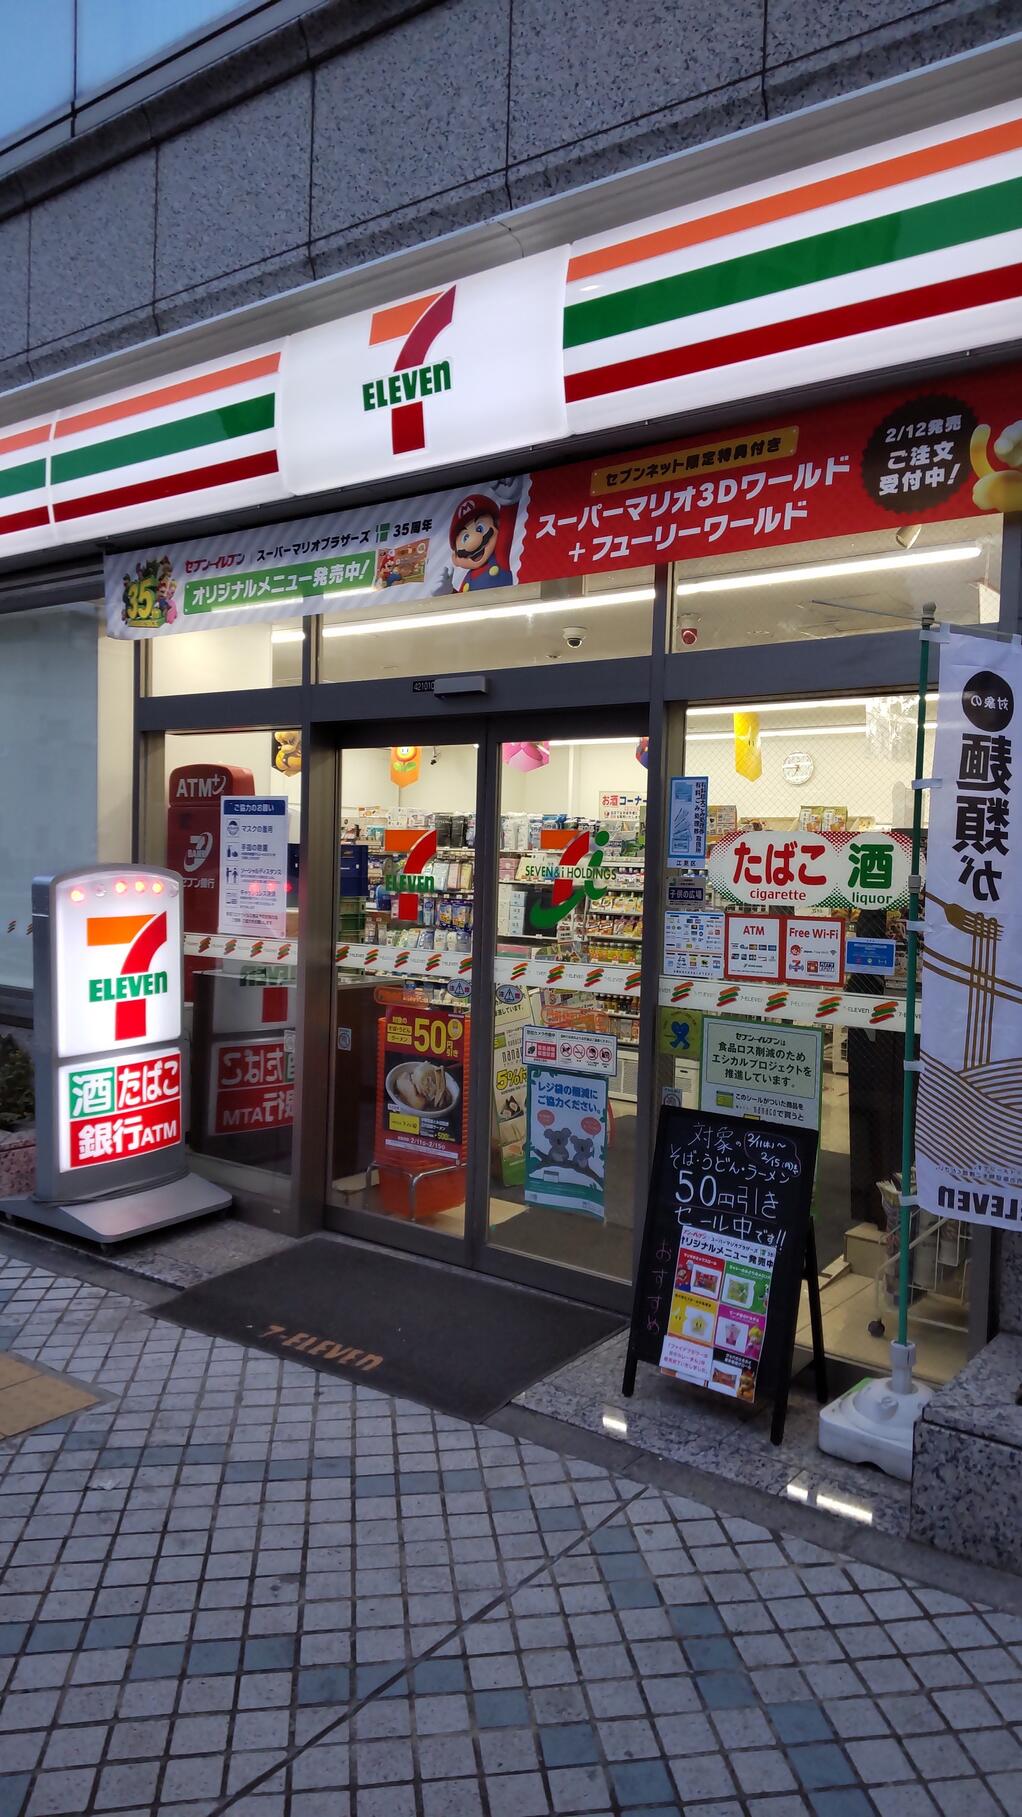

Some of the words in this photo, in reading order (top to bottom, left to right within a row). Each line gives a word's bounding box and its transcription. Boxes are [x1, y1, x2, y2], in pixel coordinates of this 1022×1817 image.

[885, 414, 962, 443] 2/12発売
[606, 437, 782, 486] セブンネット限定特典付き
[887, 440, 955, 470] ご注文
[878, 463, 961, 496] 受付中!
[535, 455, 851, 540] スーパーマリオ3Dワールド
[257, 530, 370, 561] スーパーマリオブラザーズ
[393, 518, 433, 537] 35周年
[192, 559, 370, 606] オリジナルメニュー発売中!
[566, 867, 617, 880] HOLDINGS
[733, 840, 827, 886] たばこ
[848, 843, 894, 889] 酒
[750, 888, 807, 901] cigarette
[851, 891, 893, 906] liquor
[743, 926, 765, 936] ATM
[789, 927, 810, 938] Free
[812, 929, 839, 940] Wi-Fi
[414, 1017, 447, 1055] 50
[712, 1054, 812, 1077] エシカルプロジェクトを
[718, 1041, 806, 1062] 食品ロス削減のため
[72, 1075, 113, 1117] 酒
[117, 1059, 179, 1110] たばこ
[537, 1080, 599, 1099] レジ袋の削減に
[724, 1068, 796, 1088] 推進しています。
[537, 1095, 601, 1114] ご協力ください。
[687, 1120, 742, 1154] 対象の
[675, 1169, 779, 1219] 50円引き
